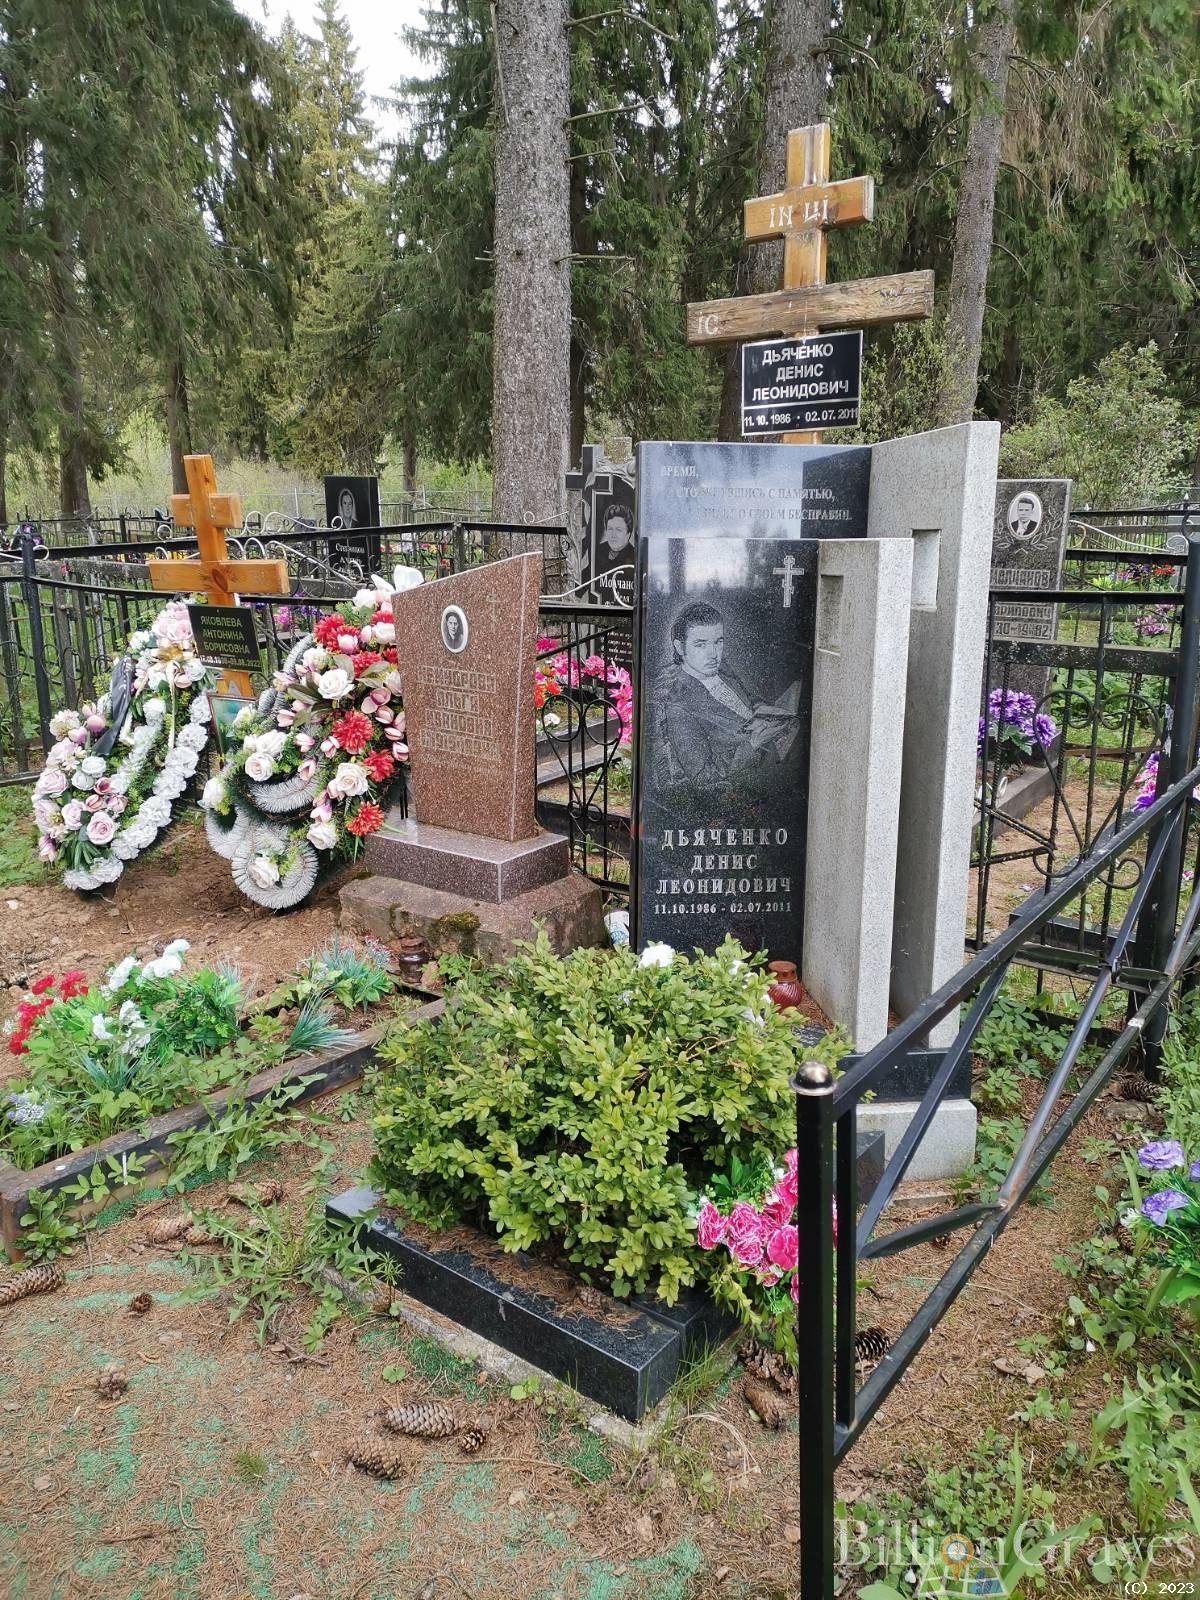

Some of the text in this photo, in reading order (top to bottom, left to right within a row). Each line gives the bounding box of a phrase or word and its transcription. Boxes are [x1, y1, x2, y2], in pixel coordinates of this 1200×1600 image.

[762, 344, 834, 366] ДЬЯЧЕНКО
[775, 363, 824, 383] ДЕНИС
[751, 380, 849, 401] ЛЕОНИДОВИЧ
[660, 465, 700, 479] ВРЕМЯ,
[778, 488, 837, 502] ПАМЯТЬЮ,
[200, 616, 242, 627] ЯКОВЛЕВА
[203, 629, 245, 641] АНТОНИНА
[203, 641, 250, 654] БОРИСОВНА
[661, 828, 789, 850] ДЬЯЧЕНКО
[690, 854, 759, 873] ДЕНИС
[655, 877, 792, 896] ЛЕОНИДОВИЧ
[653, 903, 717, 914] 11.10.1986
[729, 901, 792, 914] 02.07.2011
